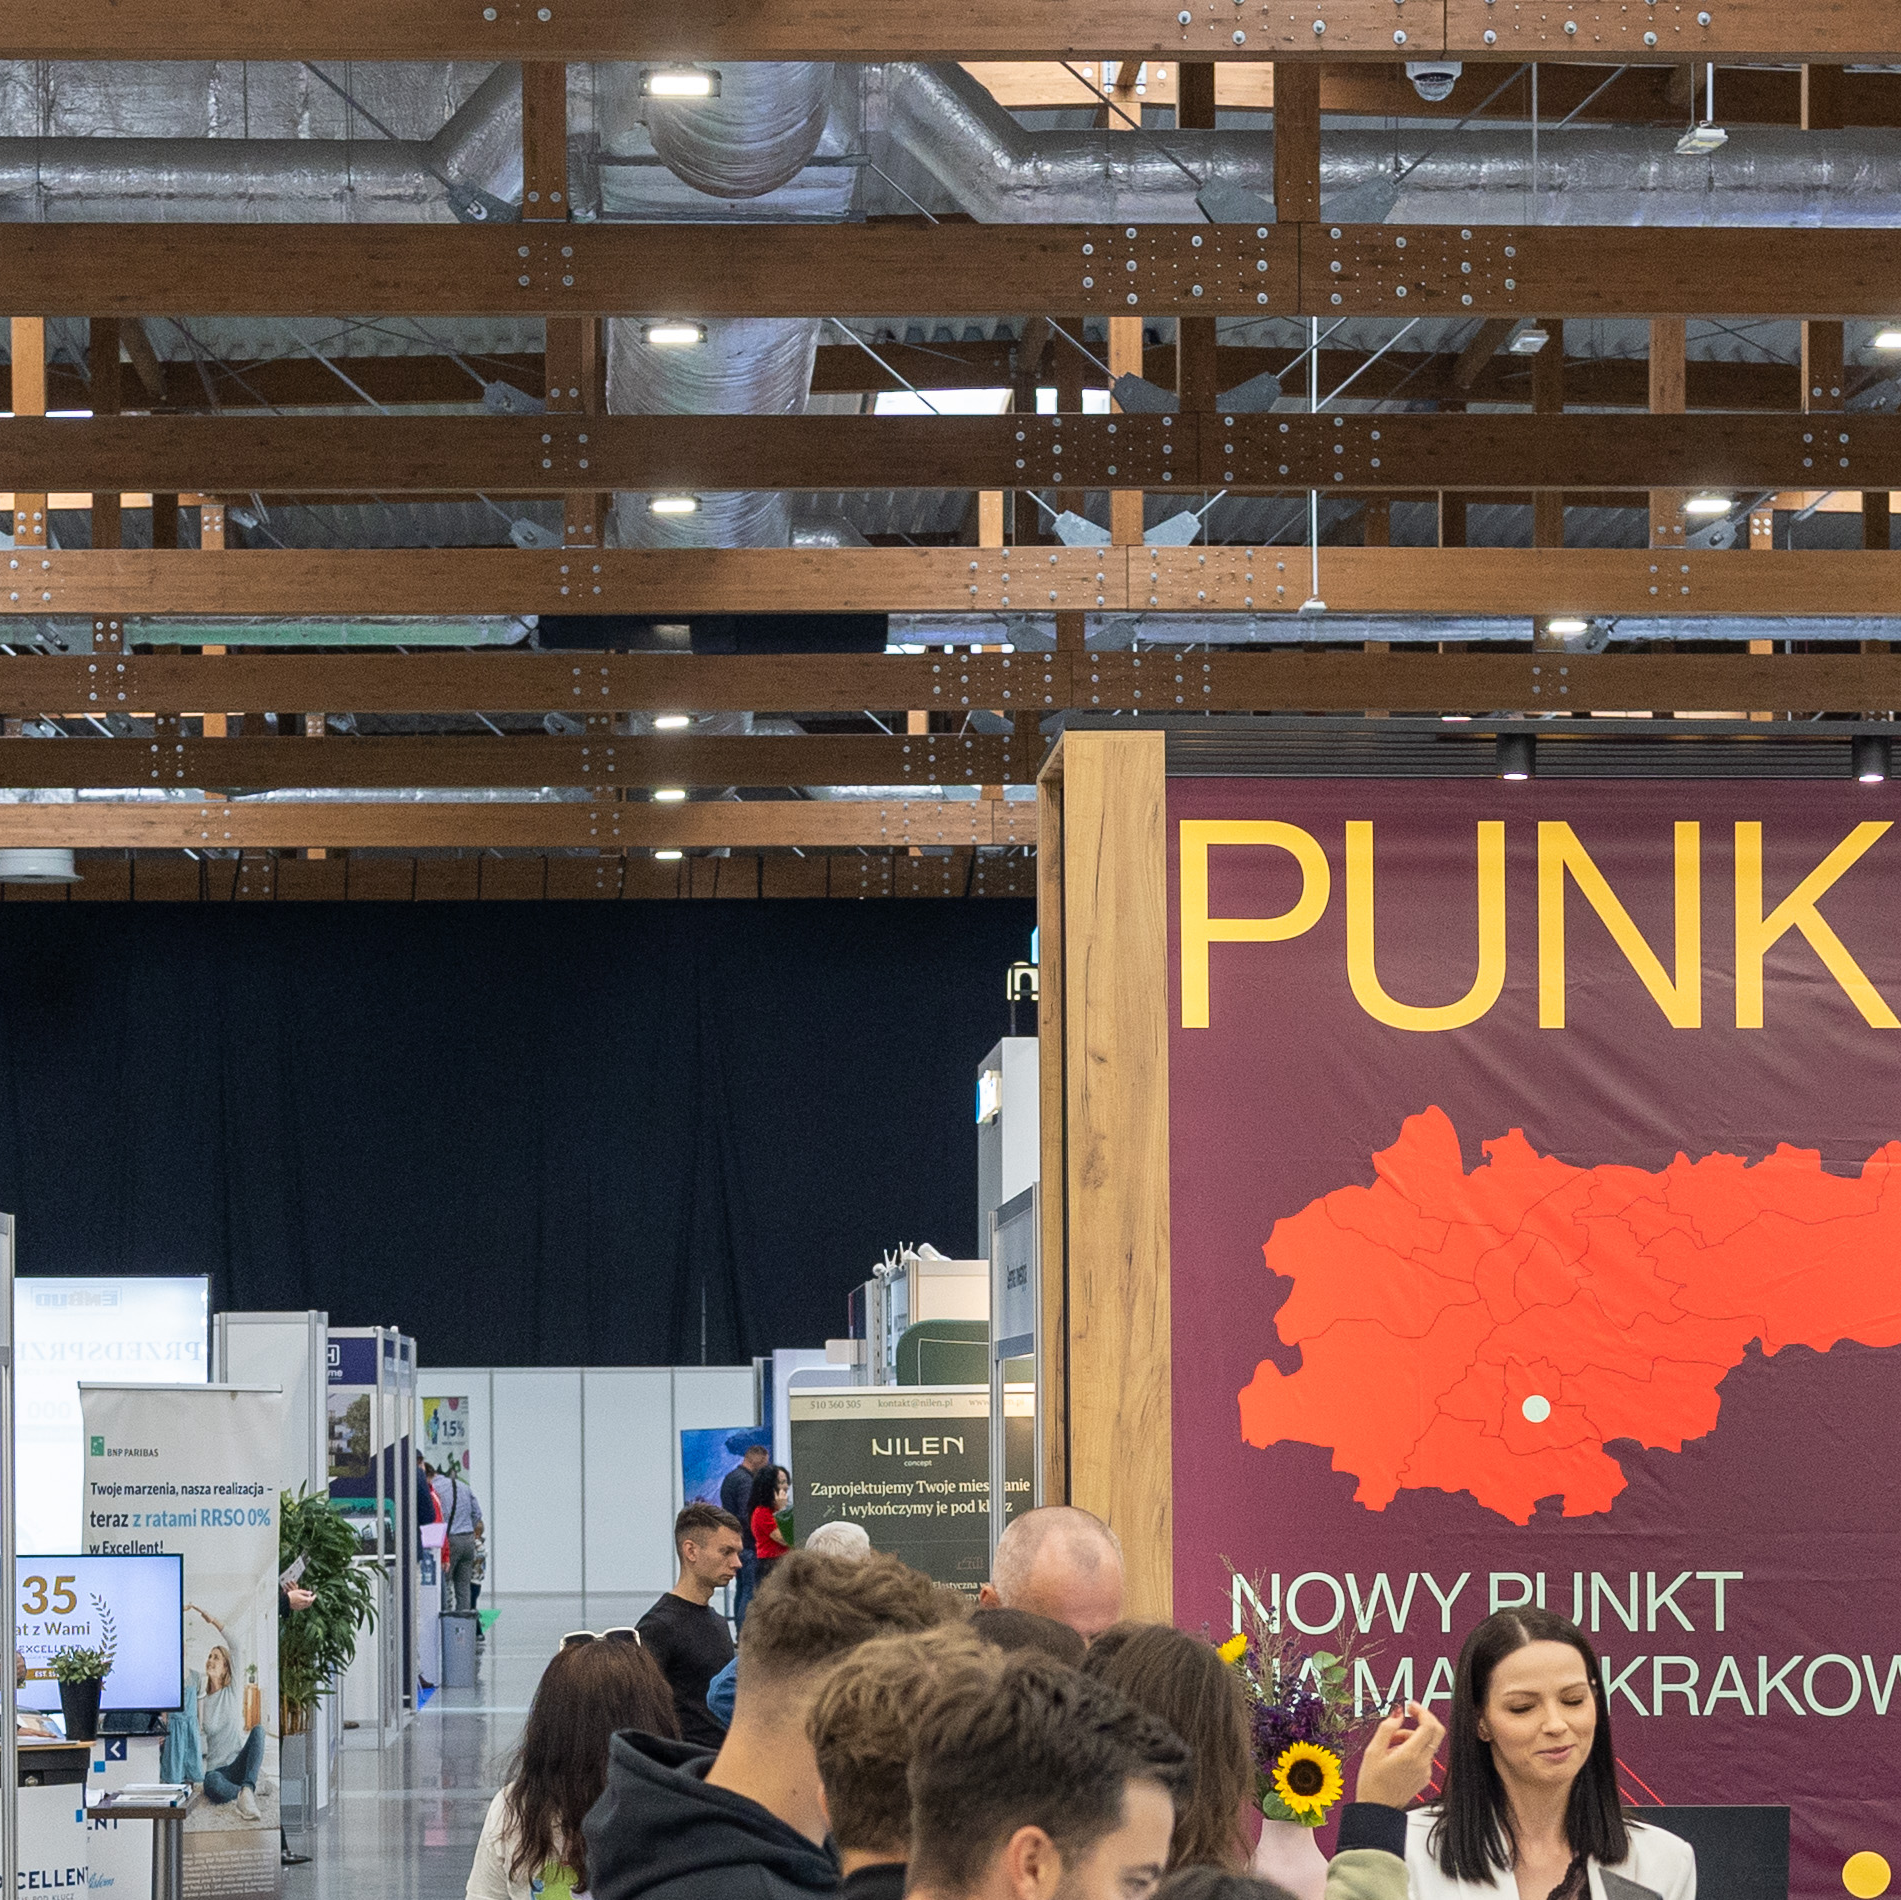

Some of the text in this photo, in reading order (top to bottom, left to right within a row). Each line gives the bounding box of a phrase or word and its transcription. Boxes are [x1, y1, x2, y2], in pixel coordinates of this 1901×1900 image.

[828, 1400, 844, 1410] 360
[846, 1399, 862, 1409] 305
[877, 1398, 954, 1409] kontakt@nilen.pl
[106, 1448, 160, 1458] BNP PARIBAS
[871, 1436, 965, 1456] NILEN
[903, 1458, 933, 1468] concept
[90, 1482, 123, 1498] Twoje
[124, 1482, 180, 1497] marzenia,
[181, 1485, 212, 1496] nasza
[214, 1482, 265, 1498] realizacja
[811, 1477, 1031, 1499] Zaprojektujemy Twoje miesanie
[841, 1499, 1014, 1518] i wykończymy je pod klz
[90, 1508, 272, 1528] teraz z ratami RRSO 0%
[89, 1539, 165, 1555] w Excellent!
[22, 1575, 78, 1616] 35
[1231, 1570, 1745, 1635] NOWY PUNKT
[32, 1625, 41, 1636] z
[44, 1621, 91, 1636] Wami
